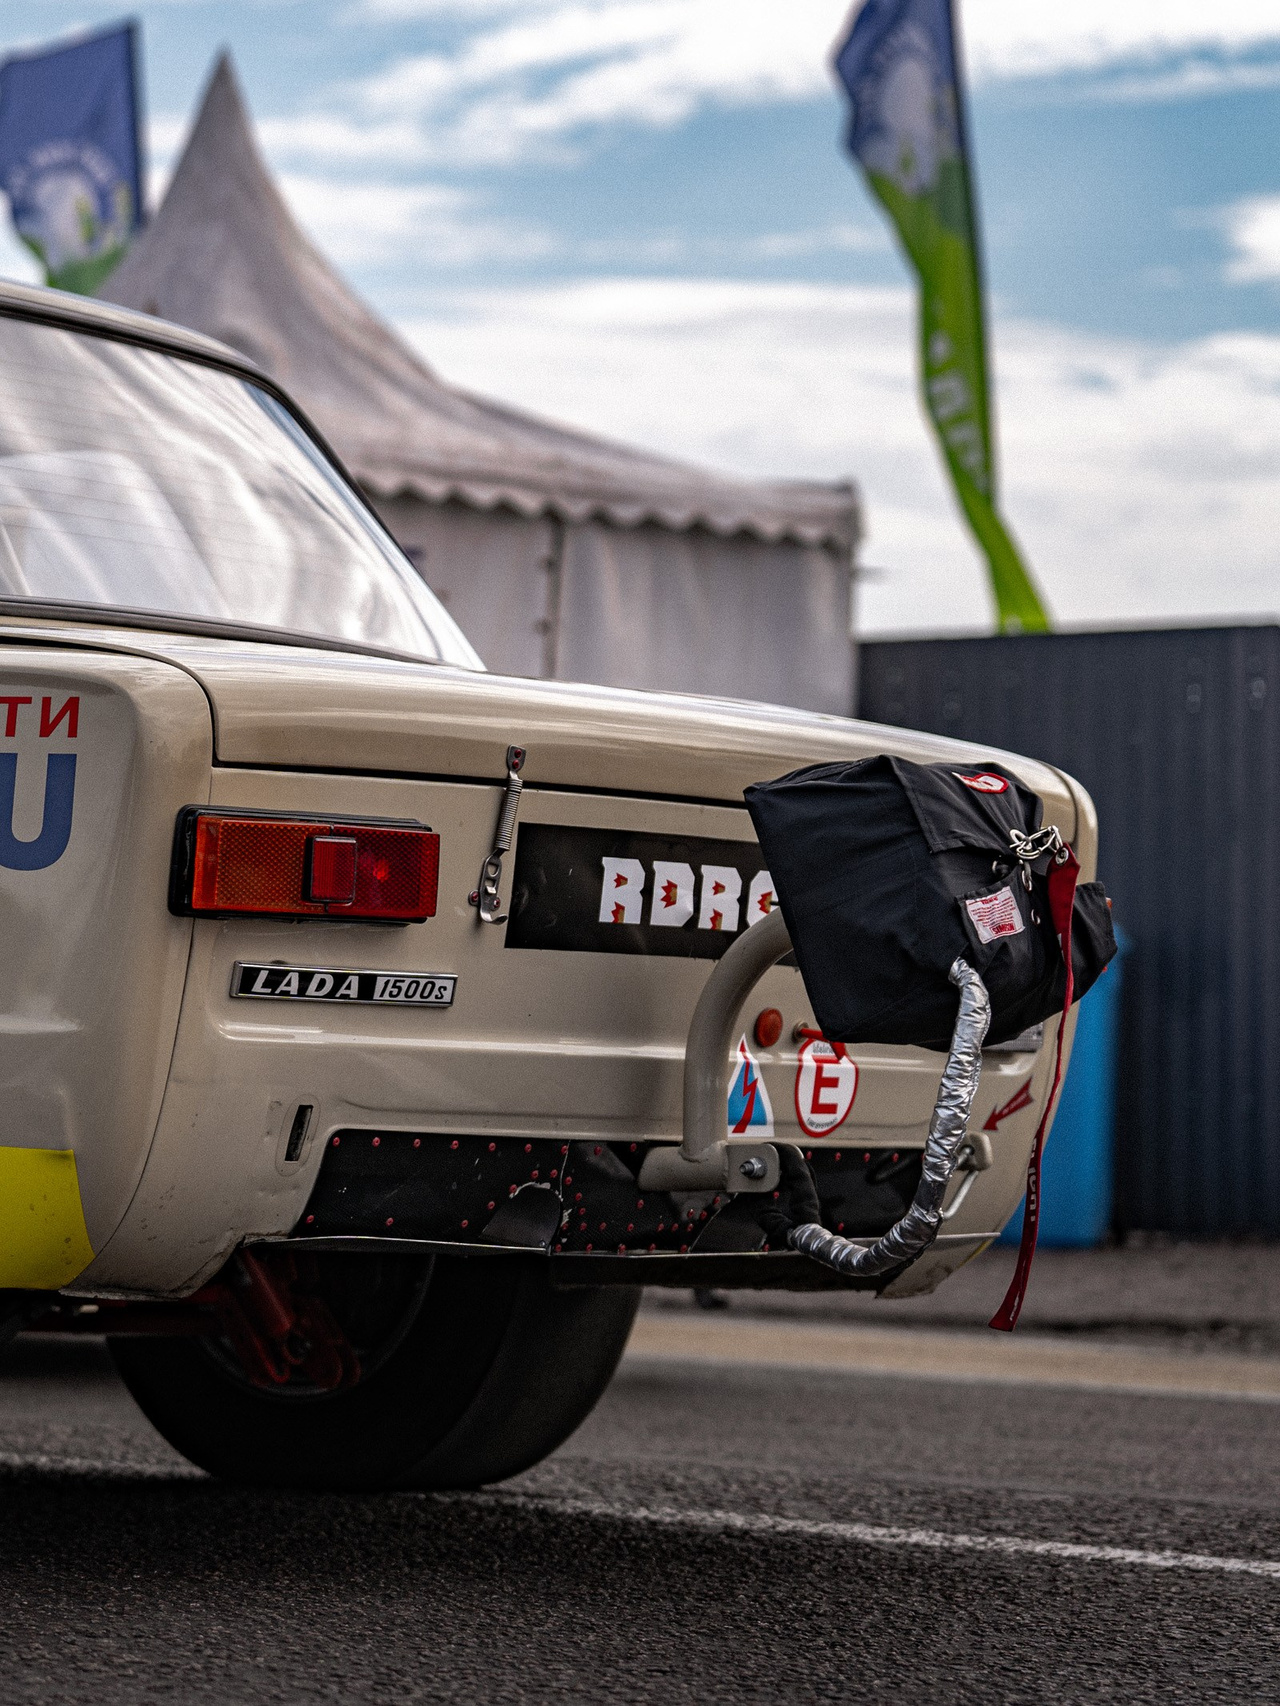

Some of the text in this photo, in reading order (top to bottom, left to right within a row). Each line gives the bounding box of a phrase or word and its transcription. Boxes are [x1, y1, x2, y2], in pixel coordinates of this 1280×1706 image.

[251, 969, 449, 1001] LADA 1500s
[810, 1054, 841, 1115] E
